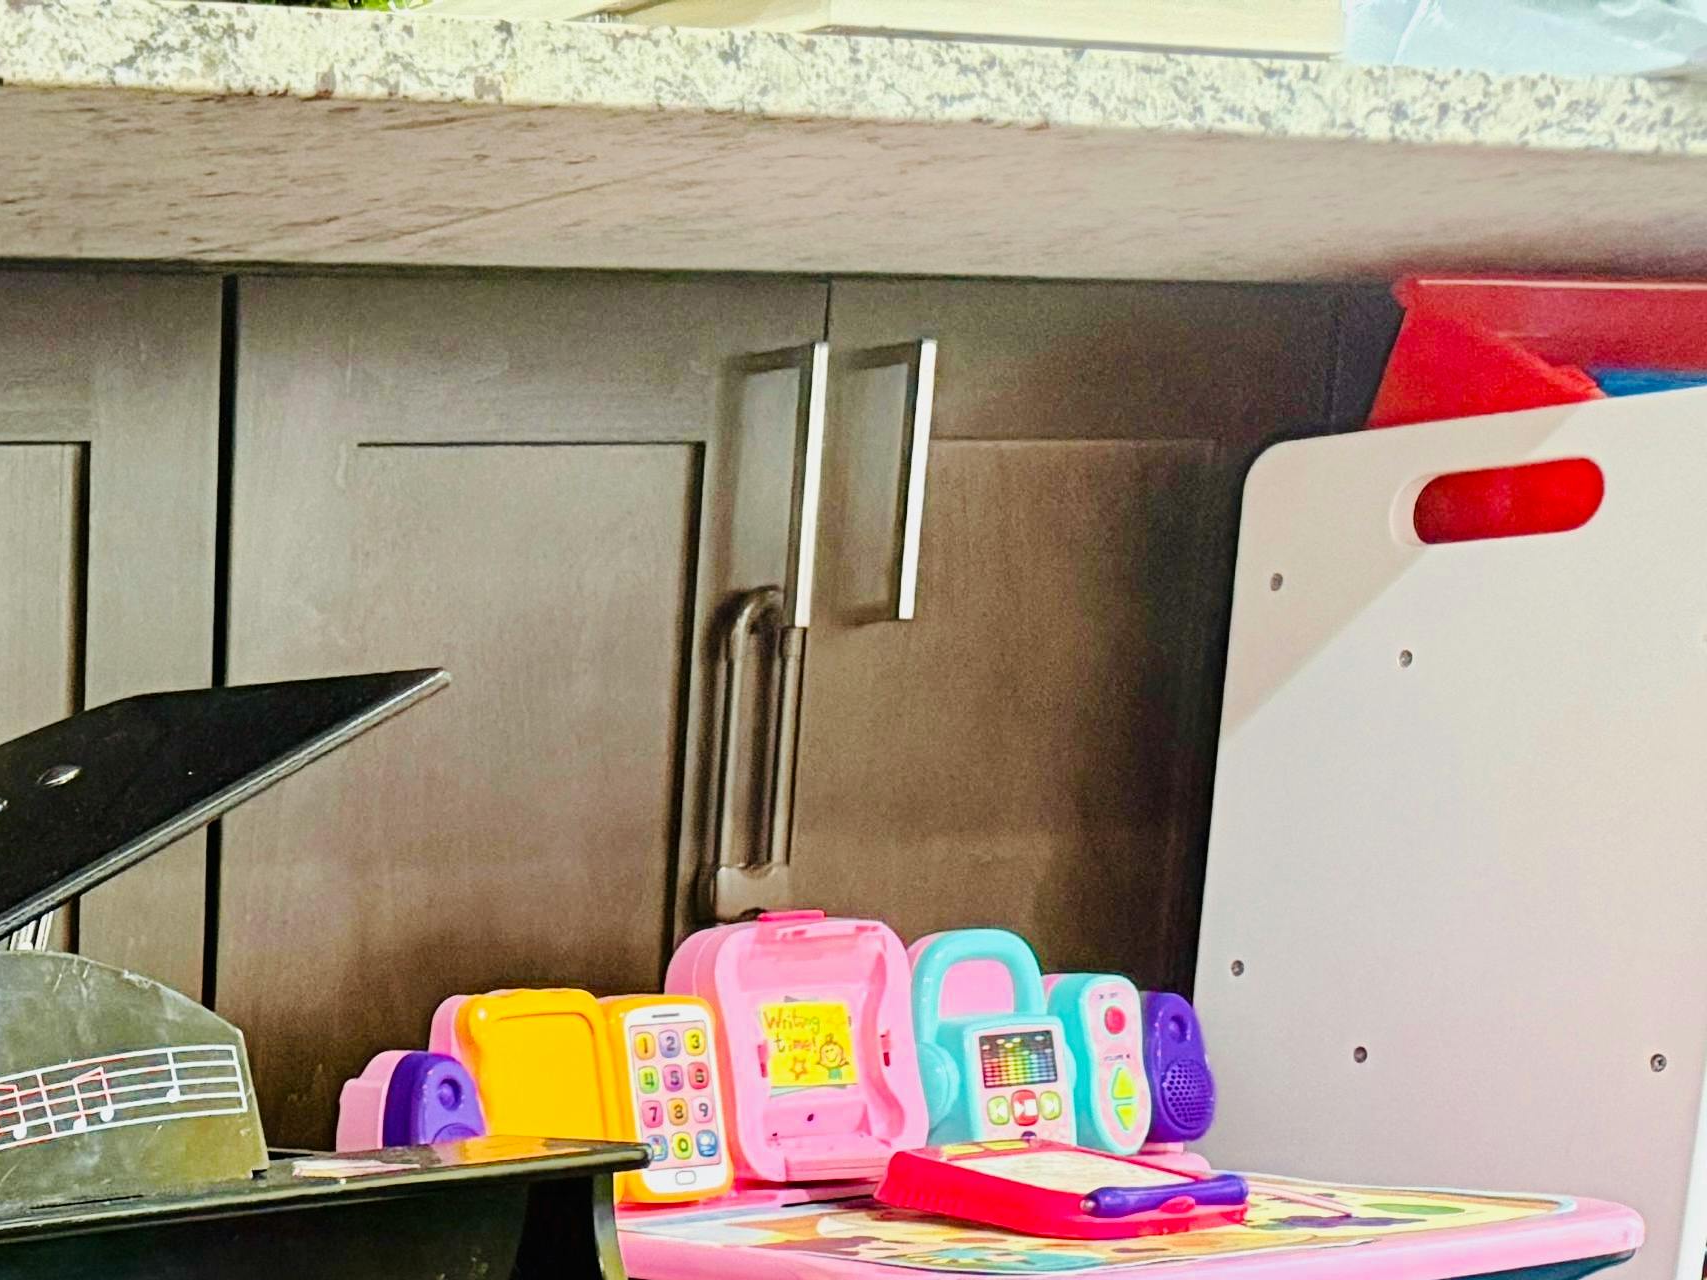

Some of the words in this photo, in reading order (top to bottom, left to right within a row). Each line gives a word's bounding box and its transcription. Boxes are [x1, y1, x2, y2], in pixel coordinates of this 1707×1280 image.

[666, 1035, 676, 1051] 2
[690, 1033, 700, 1050] 3
[643, 1071, 654, 1087] 4
[670, 1070, 680, 1086] 5
[694, 1068, 705, 1083] 6
[648, 1106, 658, 1122] 7
[673, 1103, 684, 1119] 8
[698, 1102, 709, 1118] 9
[678, 1138, 689, 1153] 0
